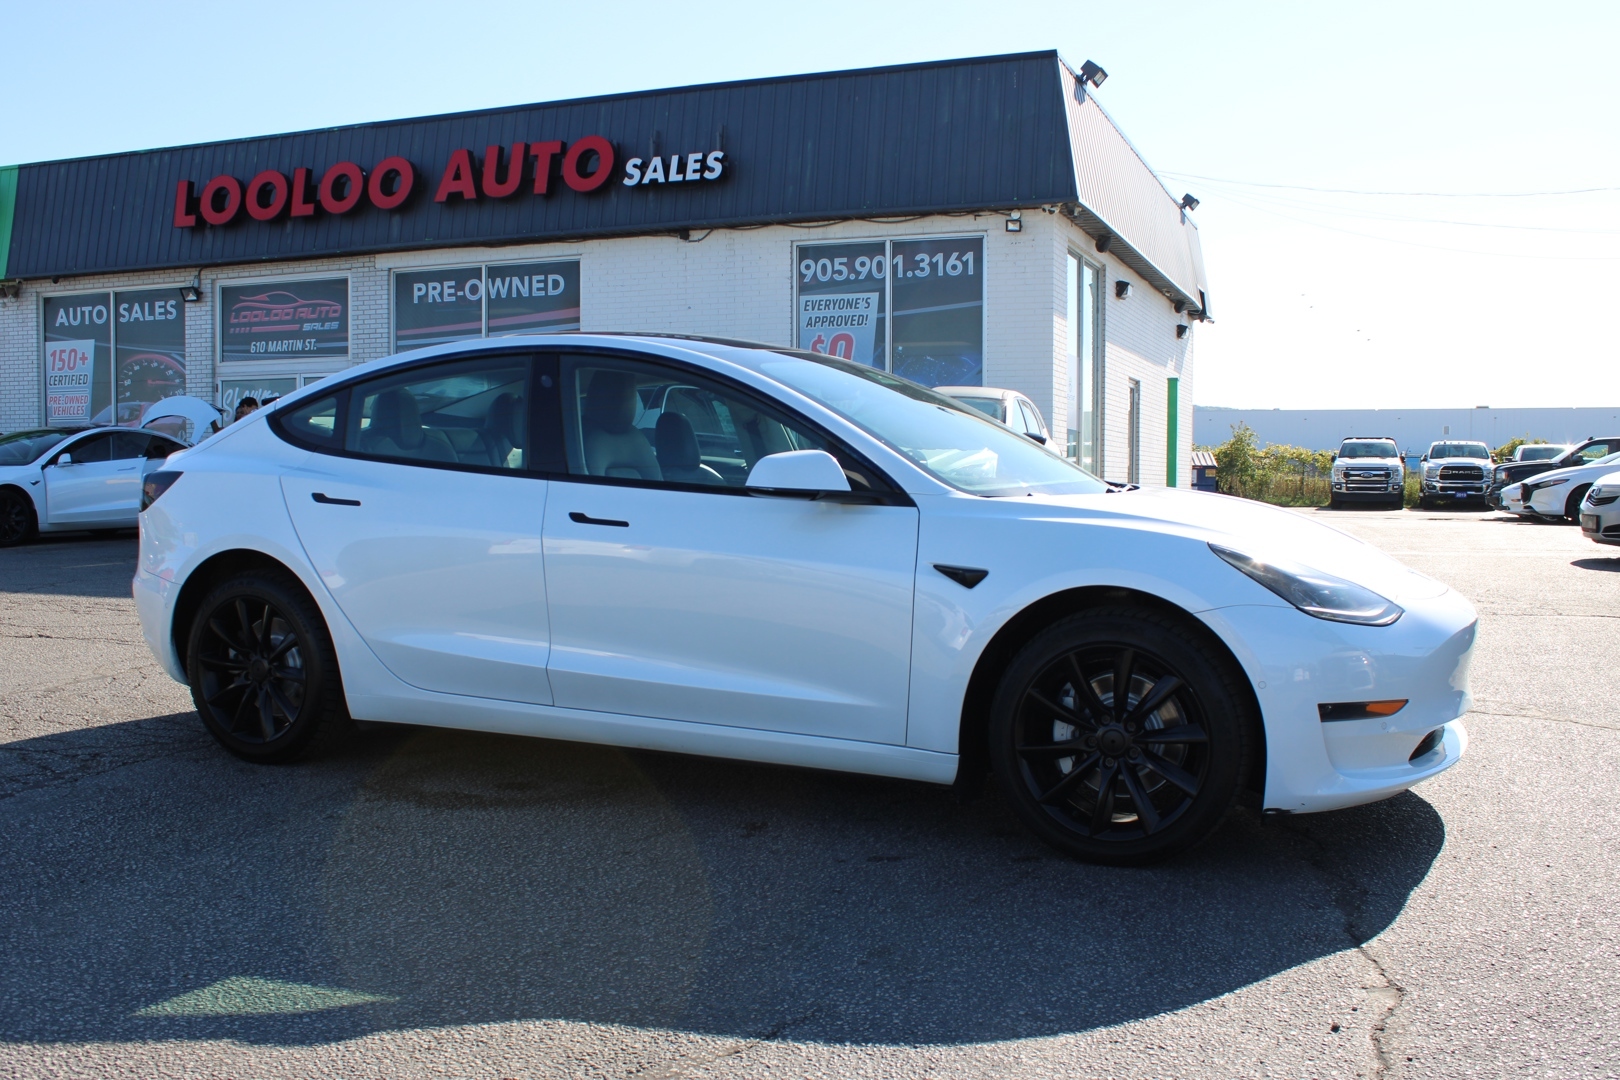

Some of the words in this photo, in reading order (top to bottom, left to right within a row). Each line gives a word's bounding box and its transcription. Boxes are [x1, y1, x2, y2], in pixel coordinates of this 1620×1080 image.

[173, 156, 414, 228] LOOLOO
[434, 135, 615, 202] AUTO
[623, 150, 724, 186] SALES
[800, 251, 974, 283] 905.901.3161
[413, 274, 565, 304] PRE-OWNED
[803, 297, 871, 312] EVERYONE'S
[55, 305, 108, 327] AUTO
[119, 300, 177, 322] SALES
[229, 308, 294, 324] LOOLOO
[295, 305, 342, 320] AUTO
[302, 321, 339, 331] SALES
[805, 314, 869, 329] APPROVED!
[250, 341, 266, 353] 610
[267, 339, 303, 352] MARTIN
[305, 339, 317, 351] ST.
[50, 348, 89, 372] 150+
[49, 374, 88, 387] CERTIFIED
[49, 395, 88, 406] PRE-OWNED
[52, 405, 85, 416] VEHICLES
